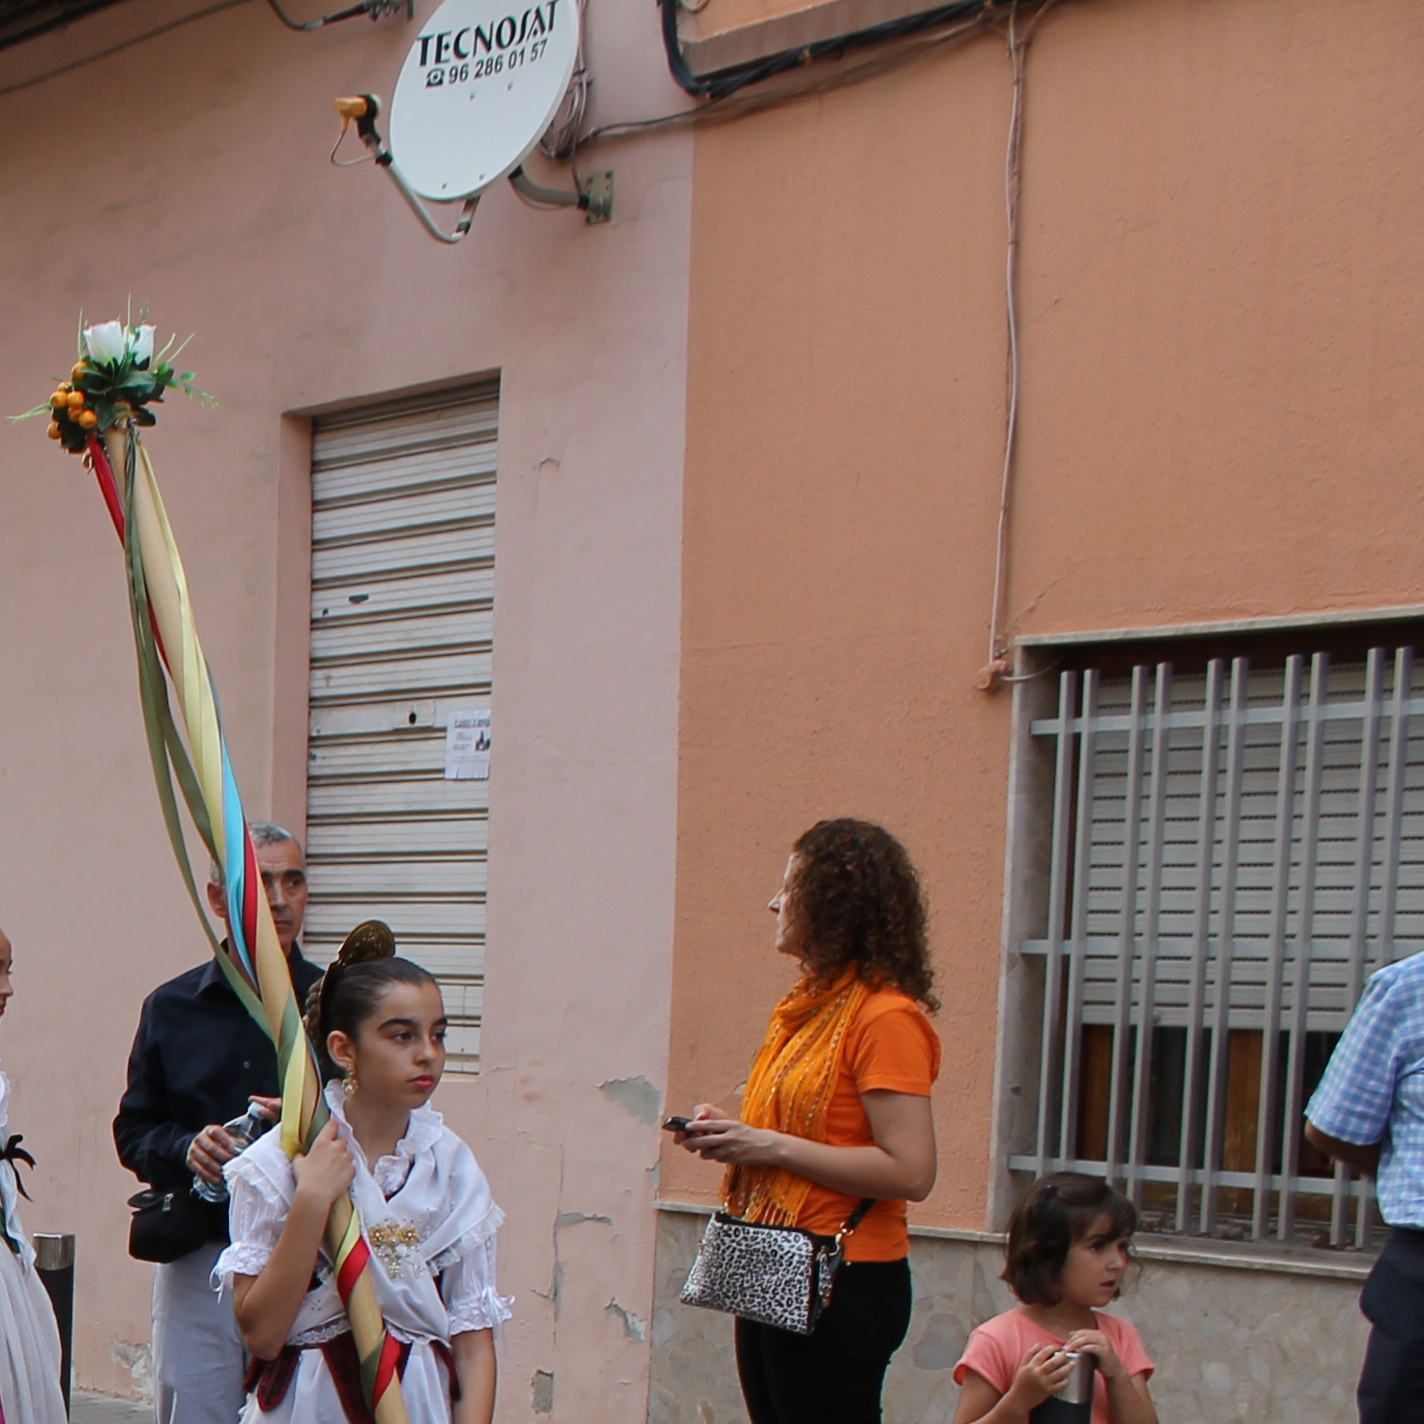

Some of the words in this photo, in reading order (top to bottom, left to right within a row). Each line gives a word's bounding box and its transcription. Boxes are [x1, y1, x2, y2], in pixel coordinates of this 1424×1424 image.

[416, 0, 558, 66] TECNOSAT
[448, 62, 469, 84] 96
[474, 53, 504, 80] 286
[508, 46, 526, 70] 01
[530, 38, 549, 63] 57
